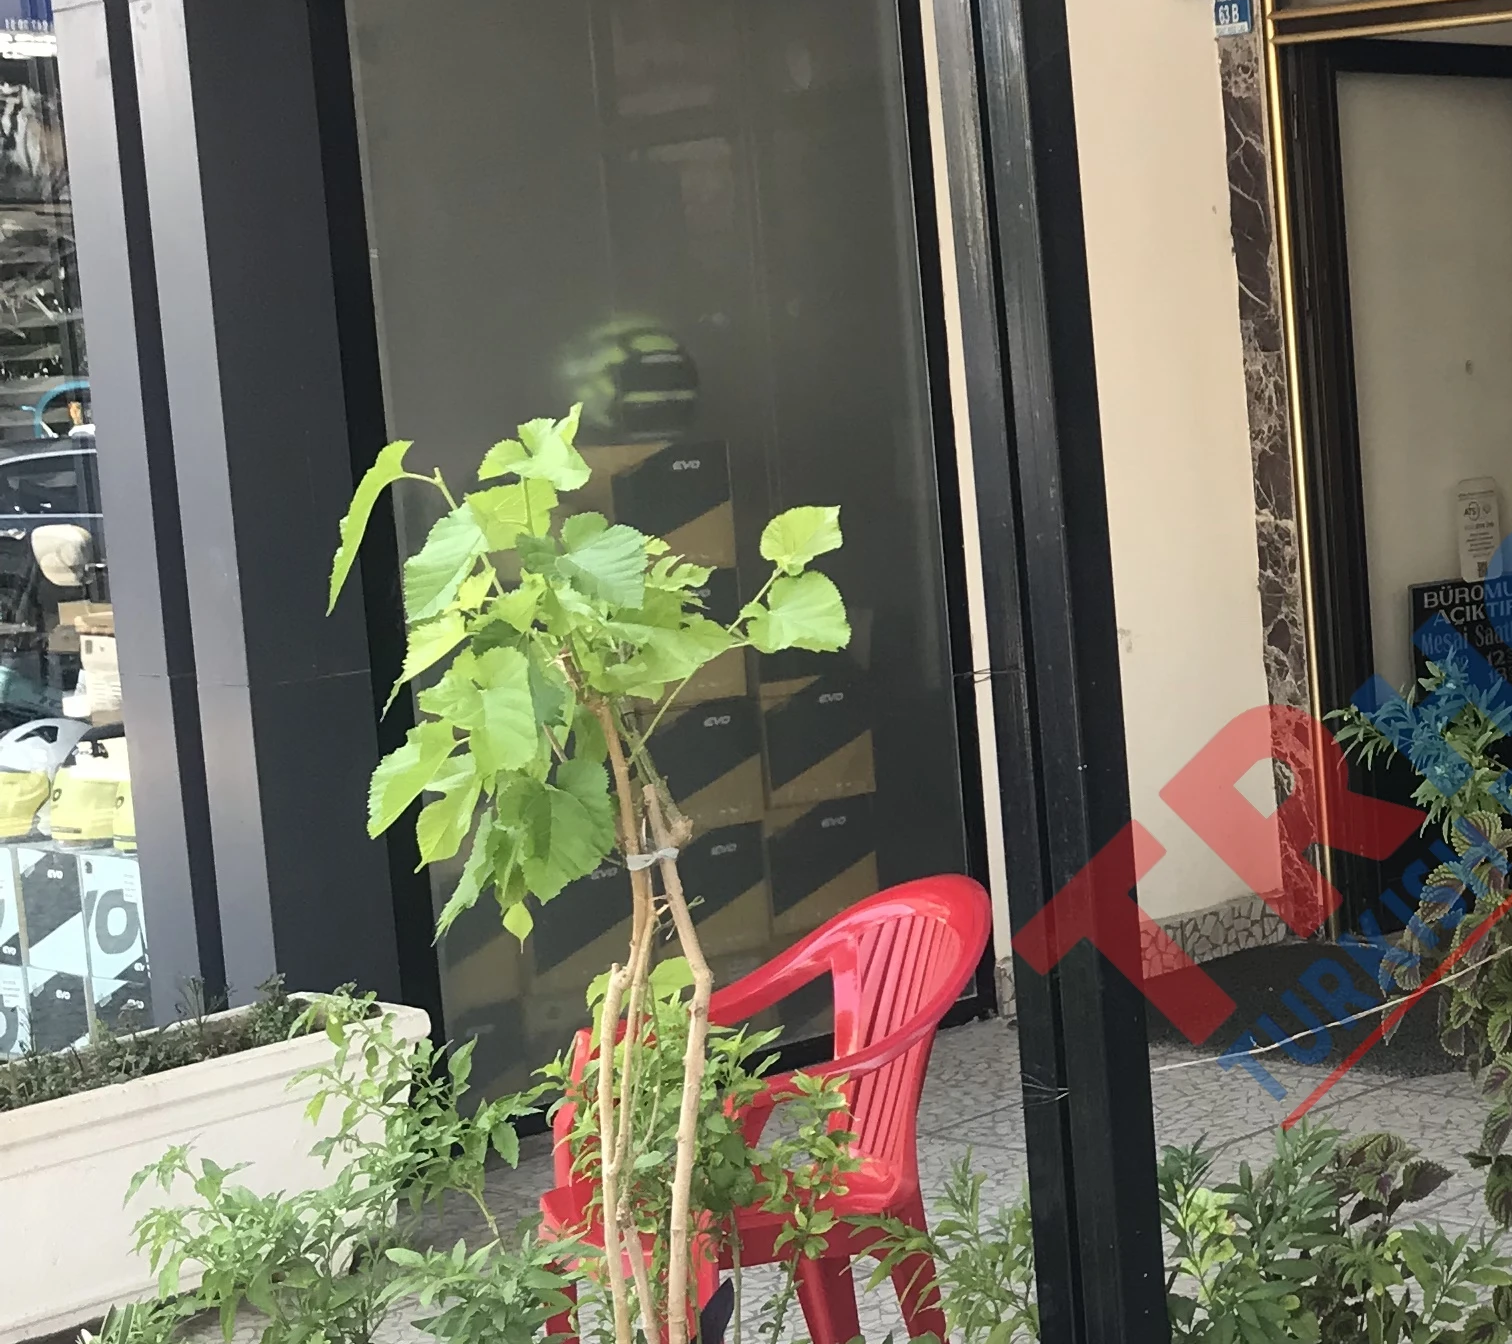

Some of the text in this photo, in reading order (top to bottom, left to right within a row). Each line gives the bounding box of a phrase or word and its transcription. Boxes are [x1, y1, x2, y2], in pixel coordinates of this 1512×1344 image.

[1218, 3, 1240, 25] 63 B
[671, 459, 702, 471] EVO
[1421, 626, 1469, 656] Mesai
[818, 691, 845, 705] EVO
[703, 714, 731, 728] EVO
[821, 815, 847, 829] EVO
[47, 869, 64, 880] EVO
[2, 945, 17, 956] EVO
[56, 988, 71, 1000] EVO
